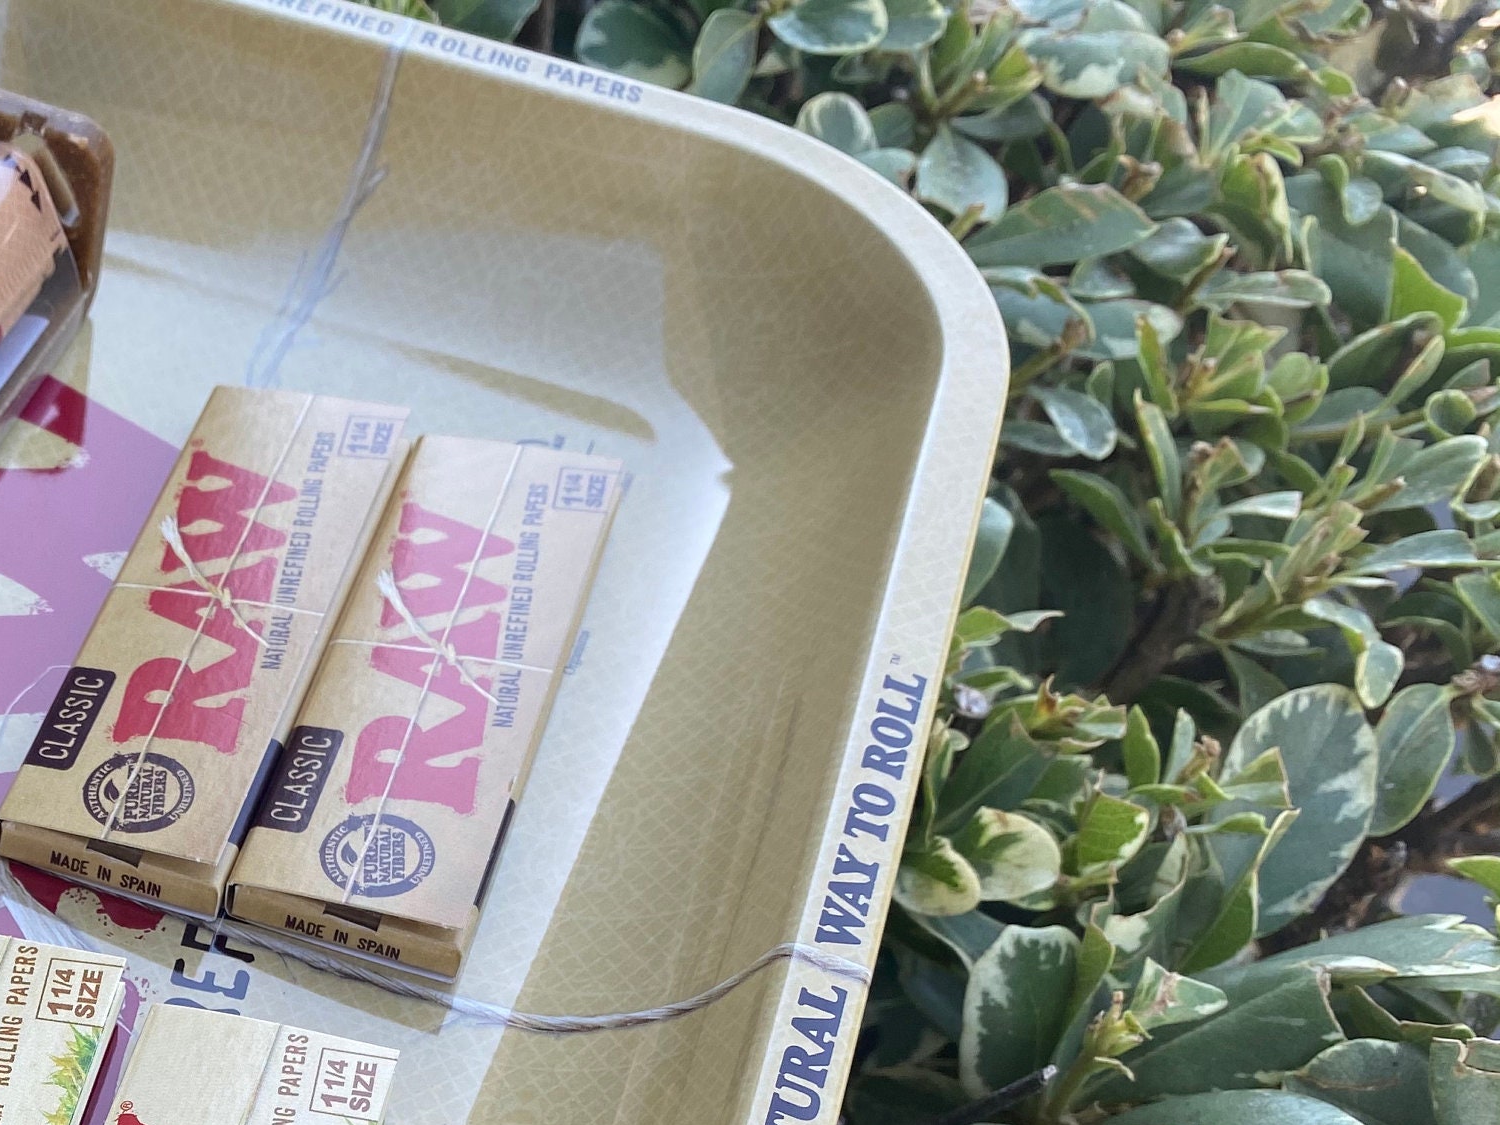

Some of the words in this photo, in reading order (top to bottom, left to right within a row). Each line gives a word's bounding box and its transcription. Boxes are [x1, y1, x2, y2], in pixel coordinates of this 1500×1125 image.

[276, 0, 394, 35] REFINED
[420, 30, 531, 73] ROLLING
[545, 63, 643, 103] PAPERS
[308, 431, 336, 474] PAPERS
[369, 422, 395, 455] SIZE
[293, 478, 323, 528] ROLLING
[522, 483, 549, 526] PAPERS
[586, 474, 607, 508] SIZE
[277, 532, 312, 604] UNREFINED
[513, 531, 540, 582] ROLLING
[111, 450, 299, 754] RAW
[502, 586, 533, 661] UNREFINED
[261, 613, 293, 670] NATURAL
[345, 503, 515, 814] RAW
[38, 676, 104, 761] CLASSIC
[492, 670, 521, 728] NATURAL
[863, 673, 926, 782] ROLL
[87, 763, 113, 819] AUTHENTIC
[152, 769, 167, 816] FIBERS
[168, 769, 190, 821] UNREFINED
[271, 735, 332, 823] CLASSIC
[846, 782, 896, 843] TO
[50, 850, 88, 876] MADE
[97, 865, 111, 882] IN
[119, 874, 161, 898] SPAIN
[324, 825, 348, 883] AUTHENTIC
[410, 830, 433, 885] UNREFINED
[814, 843, 883, 948] WAY
[284, 914, 323, 939] MADE
[333, 929, 348, 945] IN
[357, 936, 400, 960] SPAIN
[6, 944, 39, 1007] PAPERS
[74, 968, 104, 1019] SIZE
[278, 1032, 310, 1098] PAPERS
[349, 1060, 378, 1113] SIZE
